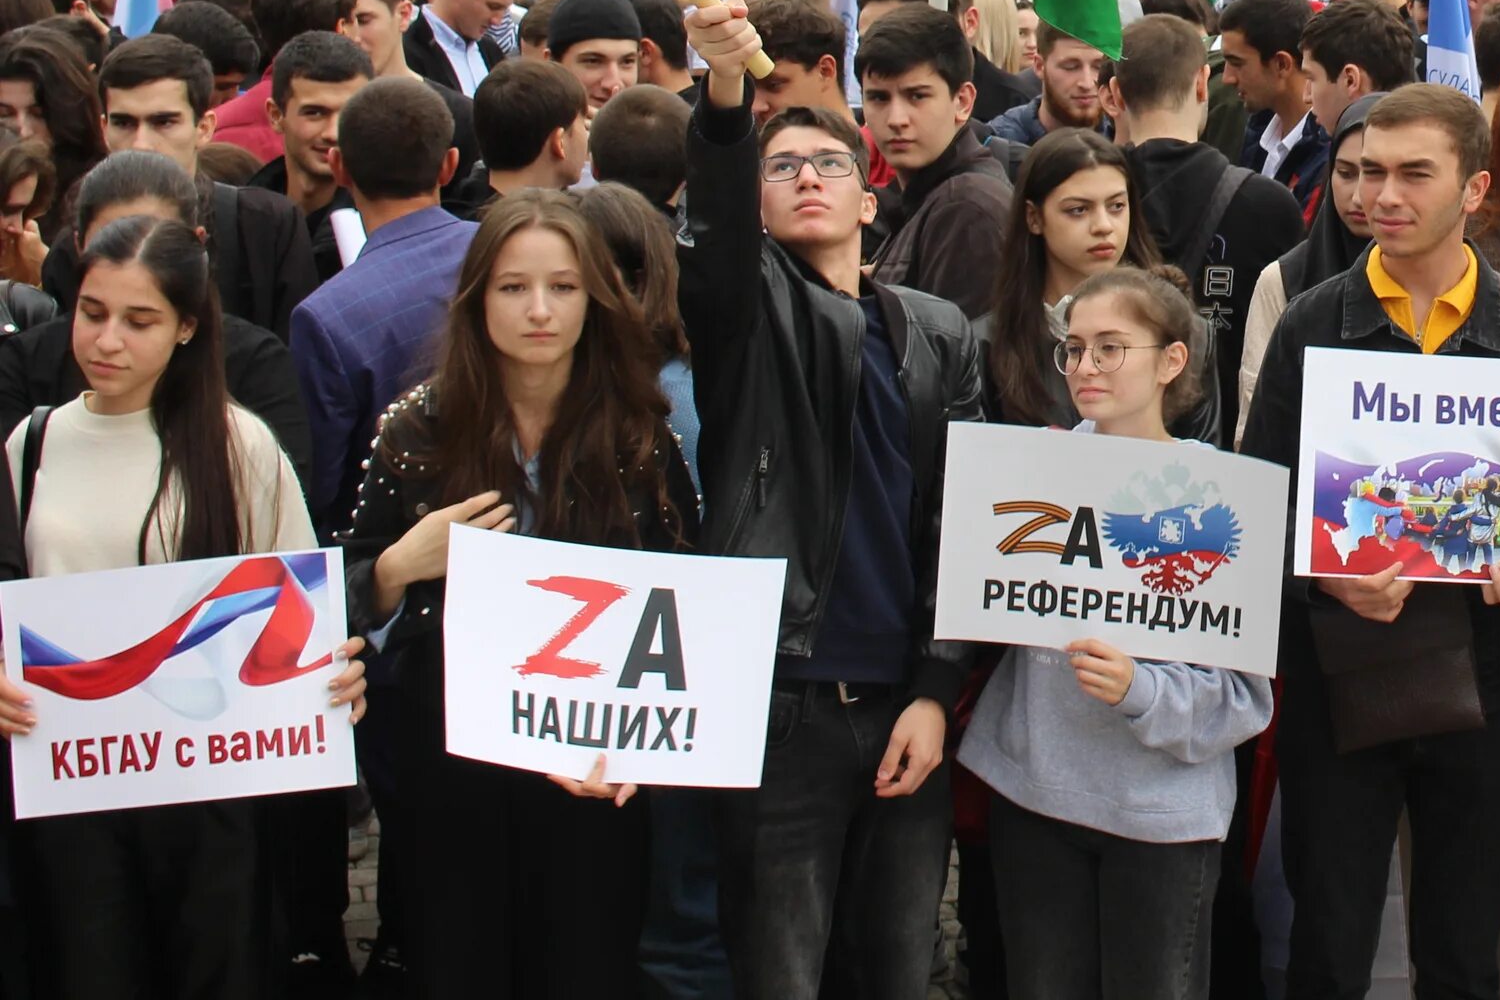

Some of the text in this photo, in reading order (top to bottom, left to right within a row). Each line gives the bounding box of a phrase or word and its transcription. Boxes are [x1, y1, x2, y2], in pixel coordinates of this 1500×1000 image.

[1352, 381, 1421, 424] Мы
[983, 579, 1242, 637] РЕФЕРЕНДУМ!
[50, 714, 326, 781] КБГАУ с вами!
[512, 690, 697, 752] НАШИХ!
